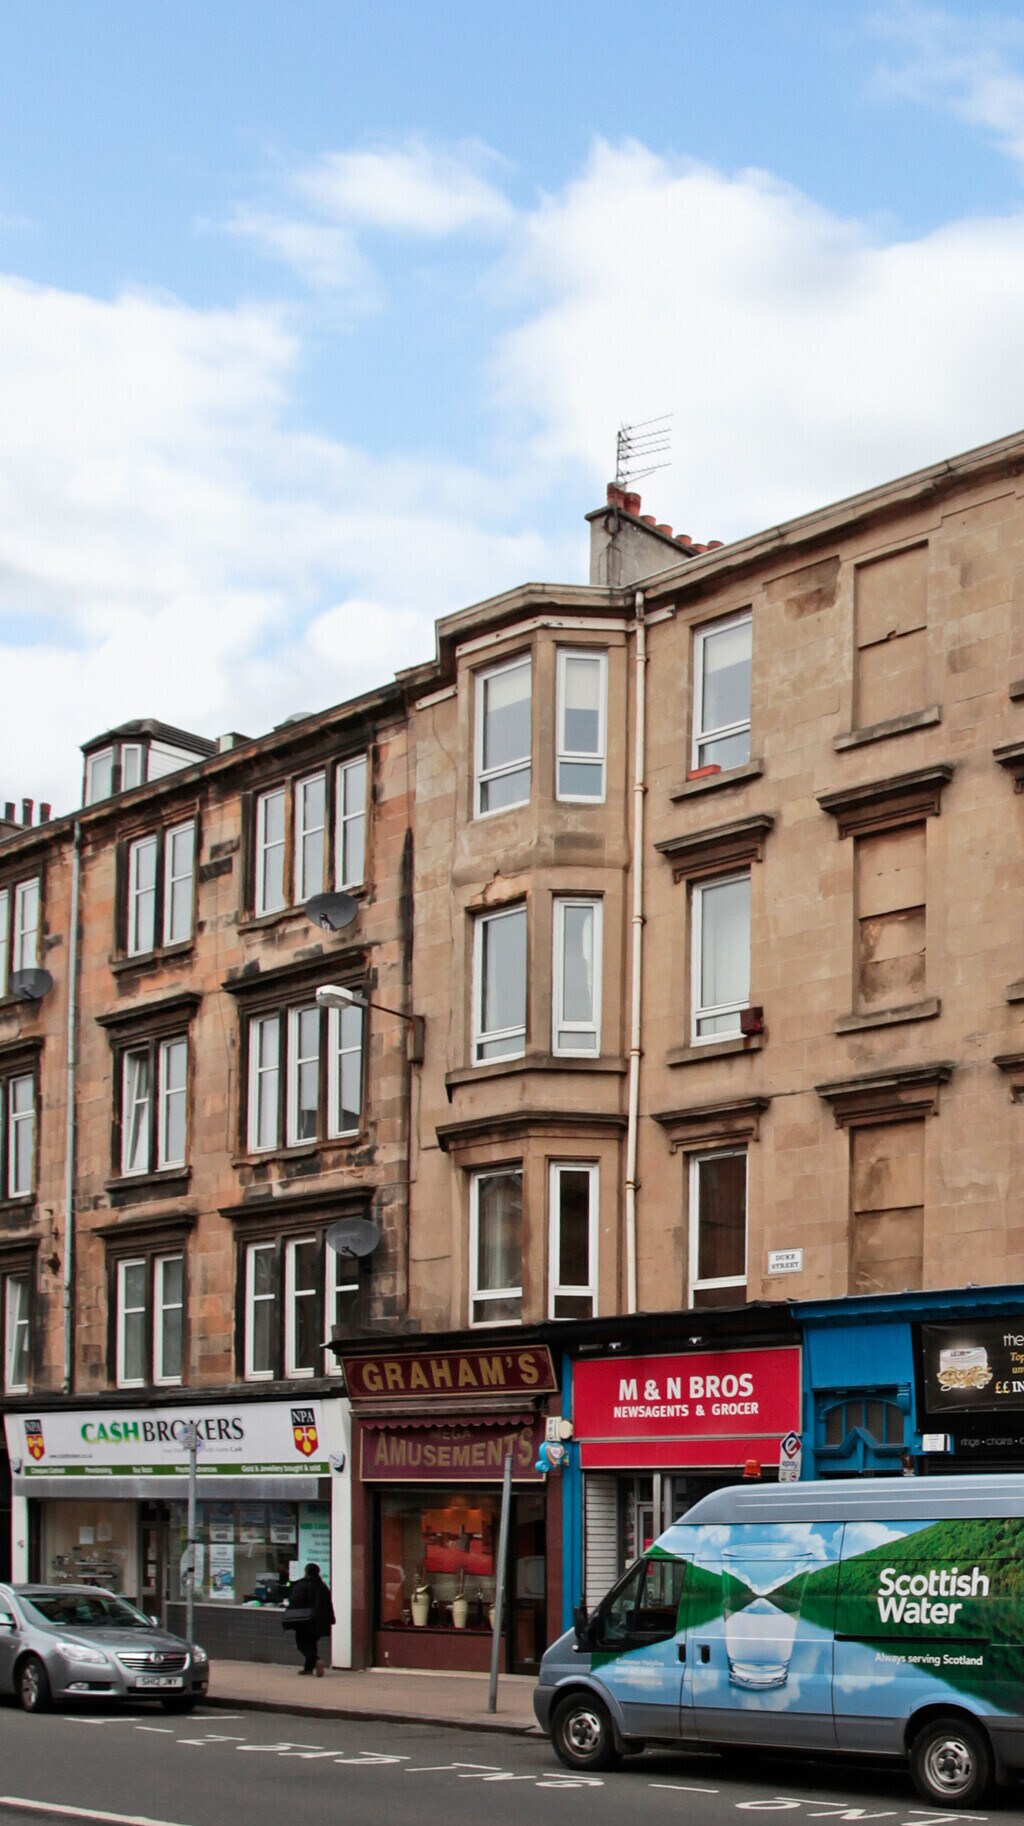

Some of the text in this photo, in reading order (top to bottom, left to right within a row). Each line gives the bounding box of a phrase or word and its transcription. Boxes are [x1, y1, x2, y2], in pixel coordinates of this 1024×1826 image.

[1003, 1333, 1024, 1346] the
[362, 1353, 540, 1391] GRAHAM'S
[618, 1373, 753, 1401] M & N BROS
[995, 1381, 1011, 1394] ££
[292, 1410, 315, 1423] NPA
[613, 1402, 759, 1418] NEWSAGENTS & GROCER
[374, 1427, 534, 1467] AMUSEMENTS
[782, 1461, 797, 1469] epay
[878, 1567, 990, 1597] Scottish
[877, 1598, 962, 1625] Water
[875, 1653, 983, 1667] Always serving Scotland
